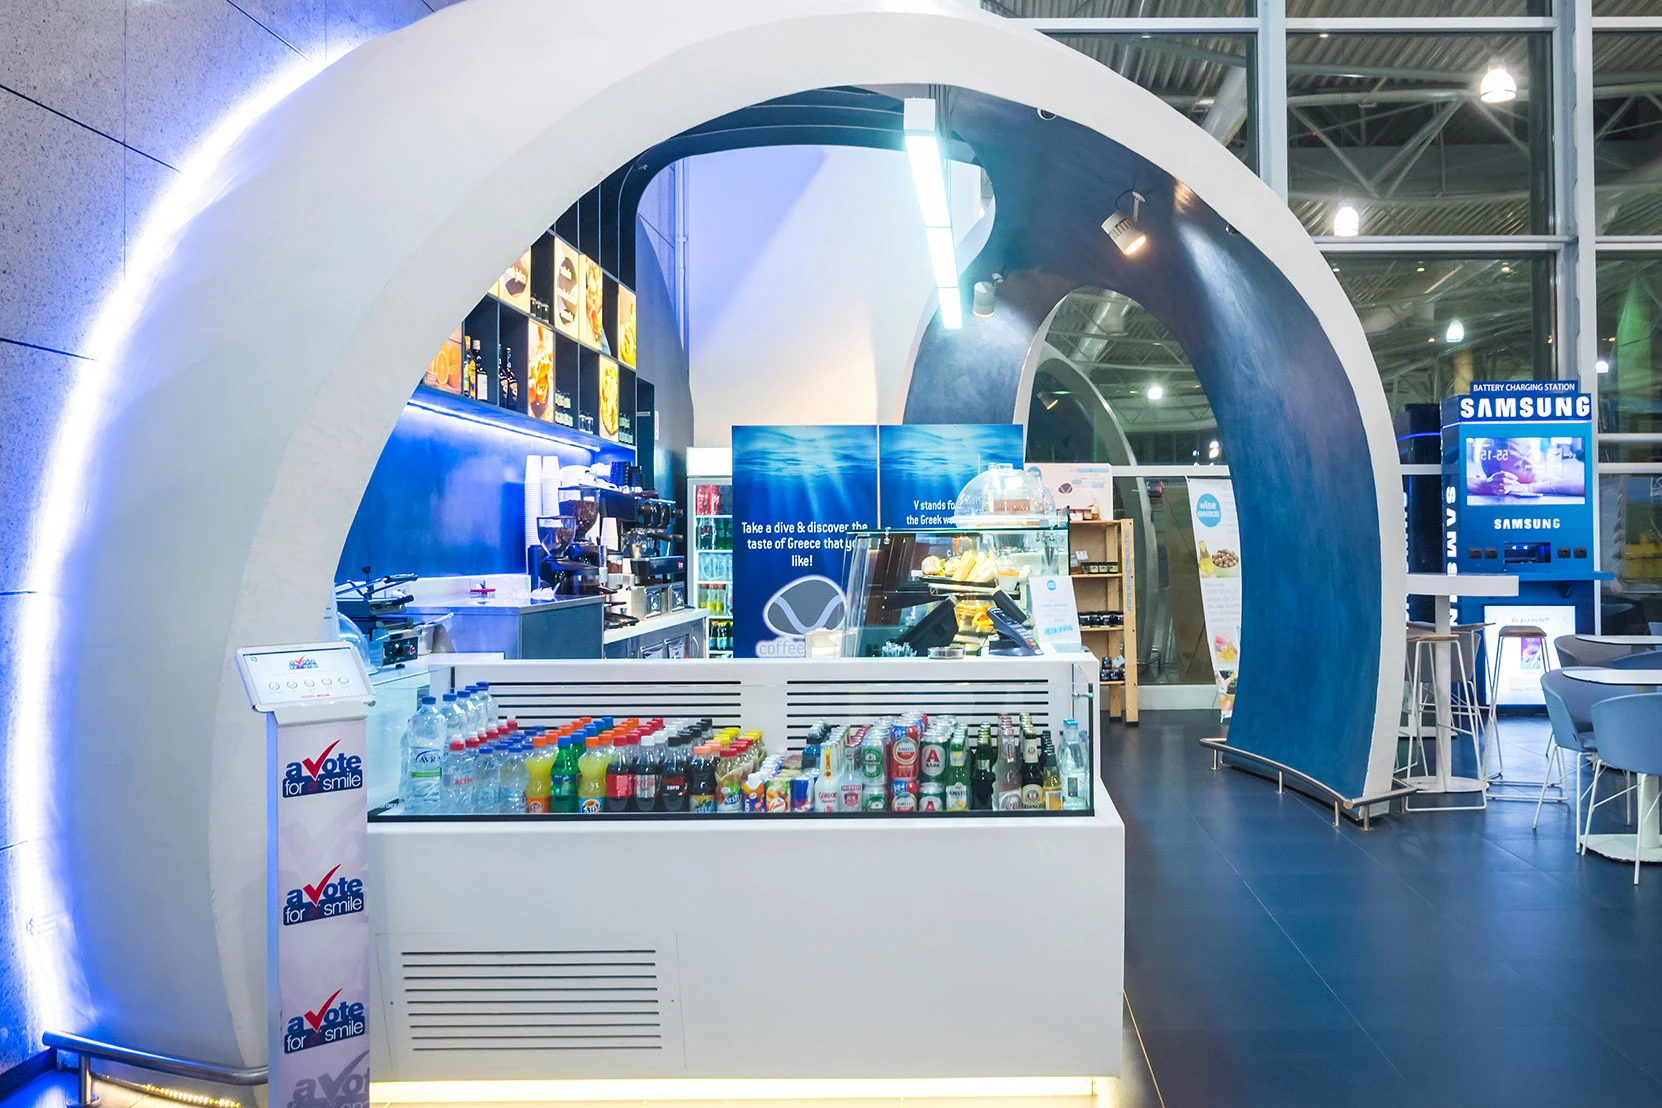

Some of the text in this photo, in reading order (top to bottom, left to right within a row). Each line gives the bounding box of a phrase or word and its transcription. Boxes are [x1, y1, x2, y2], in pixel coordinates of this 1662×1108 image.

[1544, 383, 1575, 391] STATION
[1460, 396, 1590, 418] SAMSUNG
[921, 500, 946, 510] stands
[947, 500, 957, 510] fo
[742, 522, 763, 533] Take
[765, 524, 772, 533] a
[774, 522, 795, 533] dive
[797, 521, 805, 533] &
[807, 521, 849, 533] discover
[906, 515, 919, 525] the
[920, 515, 942, 525] Greek
[1494, 518, 1561, 530] SAMSUNG
[747, 538, 773, 549] taste
[775, 538, 786, 549] of
[787, 538, 821, 549] Greece
[823, 537, 844, 549] that
[791, 555, 813, 567] like!
[1446, 486, 1458, 626] SAMSN
[926, 749, 939, 763] A
[285, 762, 302, 779] a
[285, 780, 304, 796] for
[322, 772, 361, 791] smile
[286, 889, 303, 906] a
[286, 907, 306, 923] for
[323, 896, 362, 916] smile
[287, 1016, 304, 1034] a
[287, 1035, 307, 1052] for
[324, 1020, 364, 1042] smile
